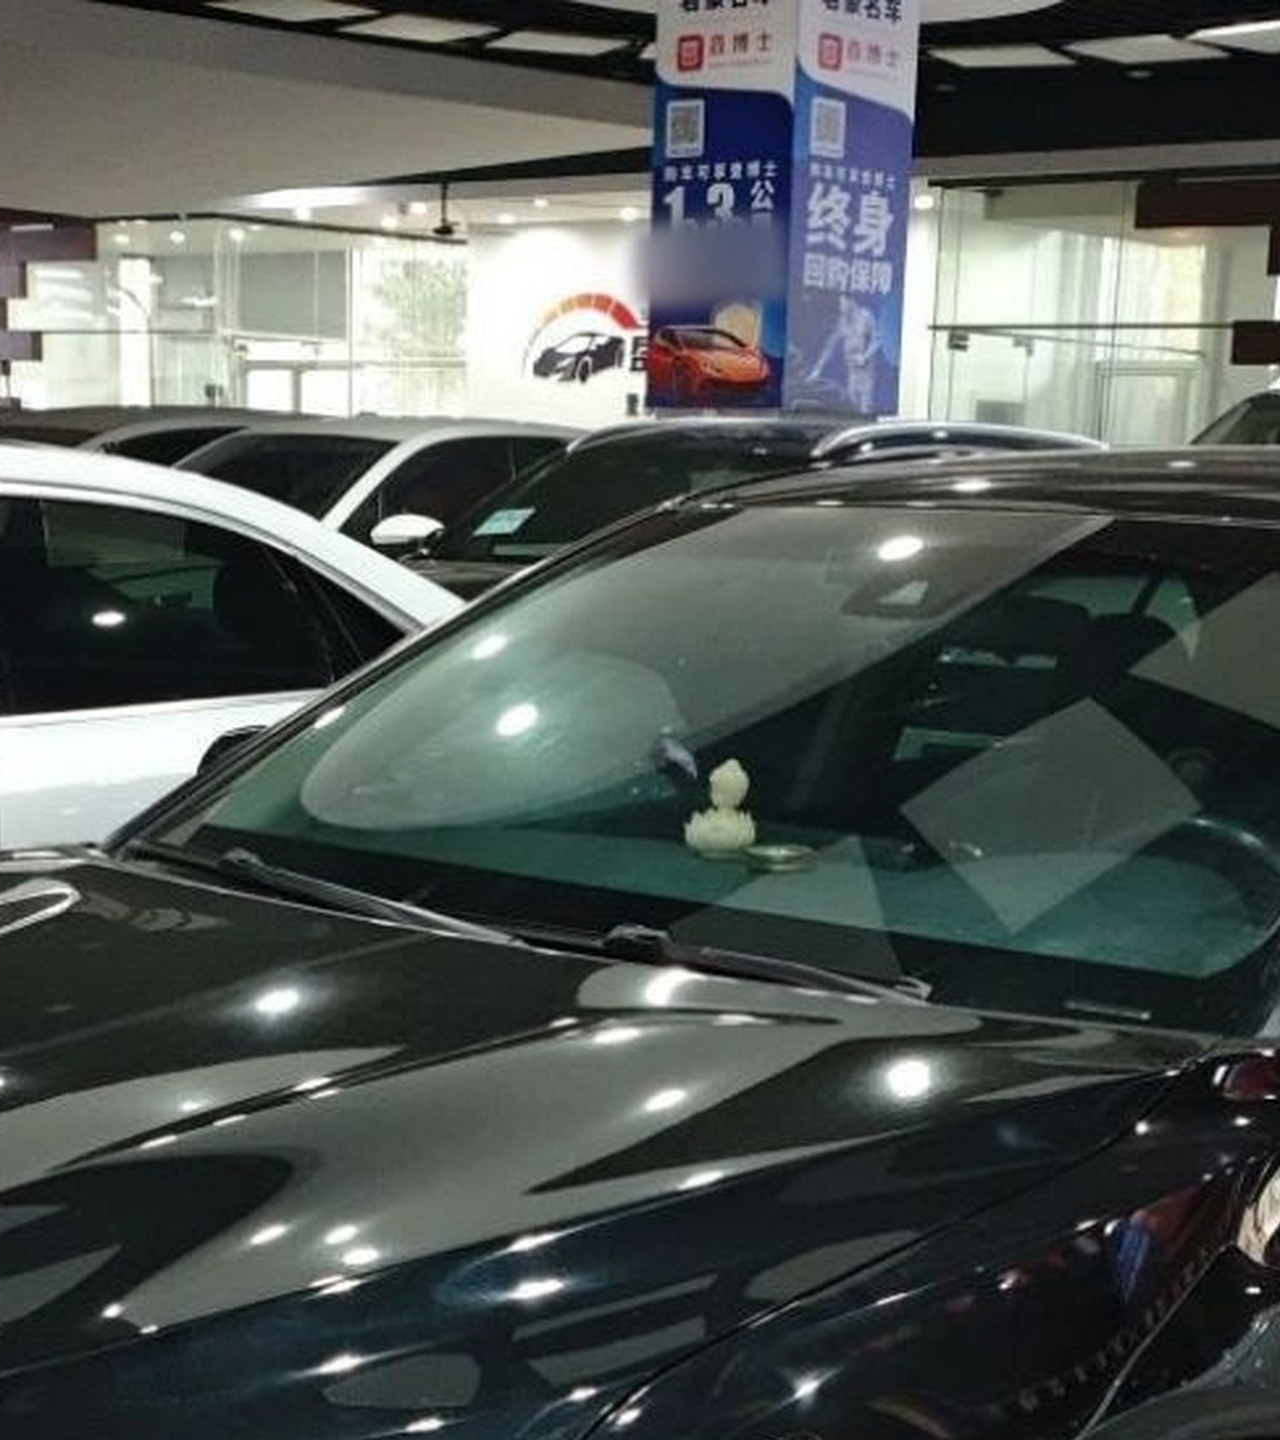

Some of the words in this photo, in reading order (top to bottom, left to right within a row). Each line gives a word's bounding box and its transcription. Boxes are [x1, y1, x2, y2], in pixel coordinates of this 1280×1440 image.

[806, 183, 893, 256] 终身
[803, 252, 893, 295] 回购保障
